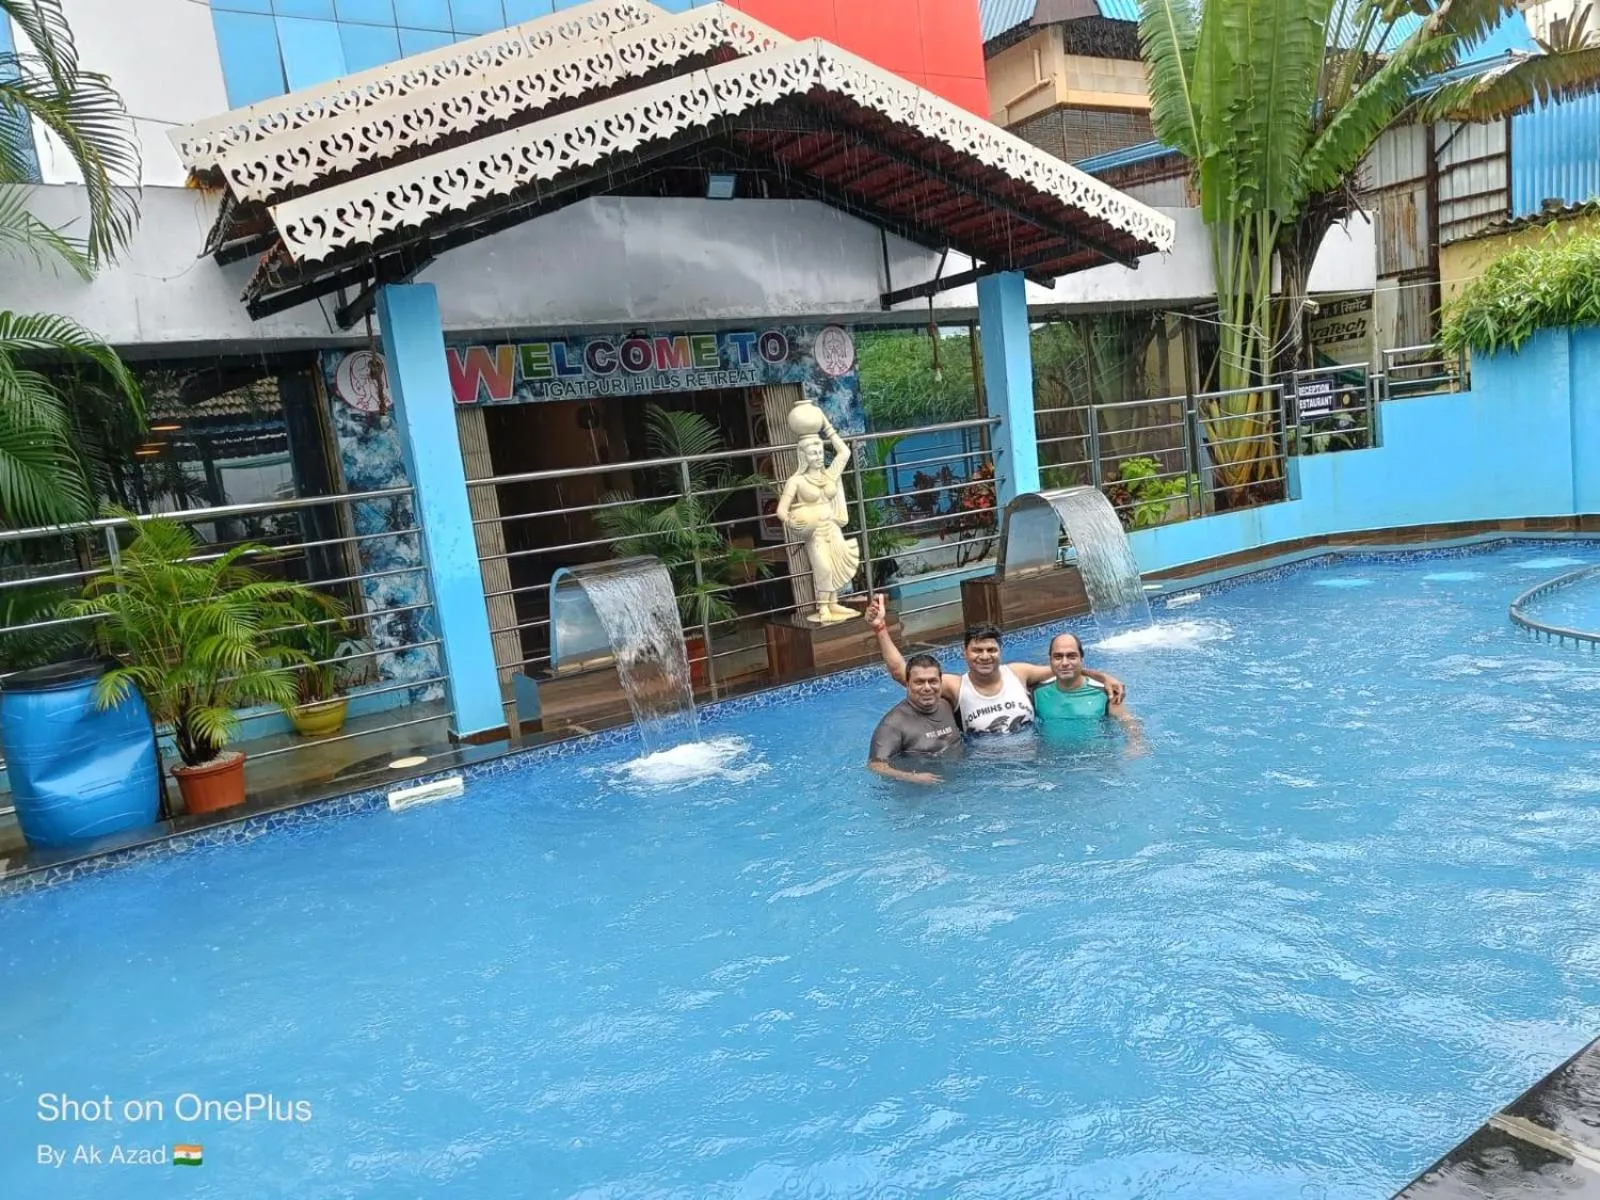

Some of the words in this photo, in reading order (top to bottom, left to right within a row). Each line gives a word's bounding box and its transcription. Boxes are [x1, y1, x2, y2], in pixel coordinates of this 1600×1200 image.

[446, 335, 720, 404] WELCOME
[728, 331, 788, 365] TO
[543, 377, 629, 398] IGATPURI
[634, 374, 681, 392] HILLS
[687, 369, 758, 387] RETREAT
[1299, 396, 1332, 409] ESTAURANT
